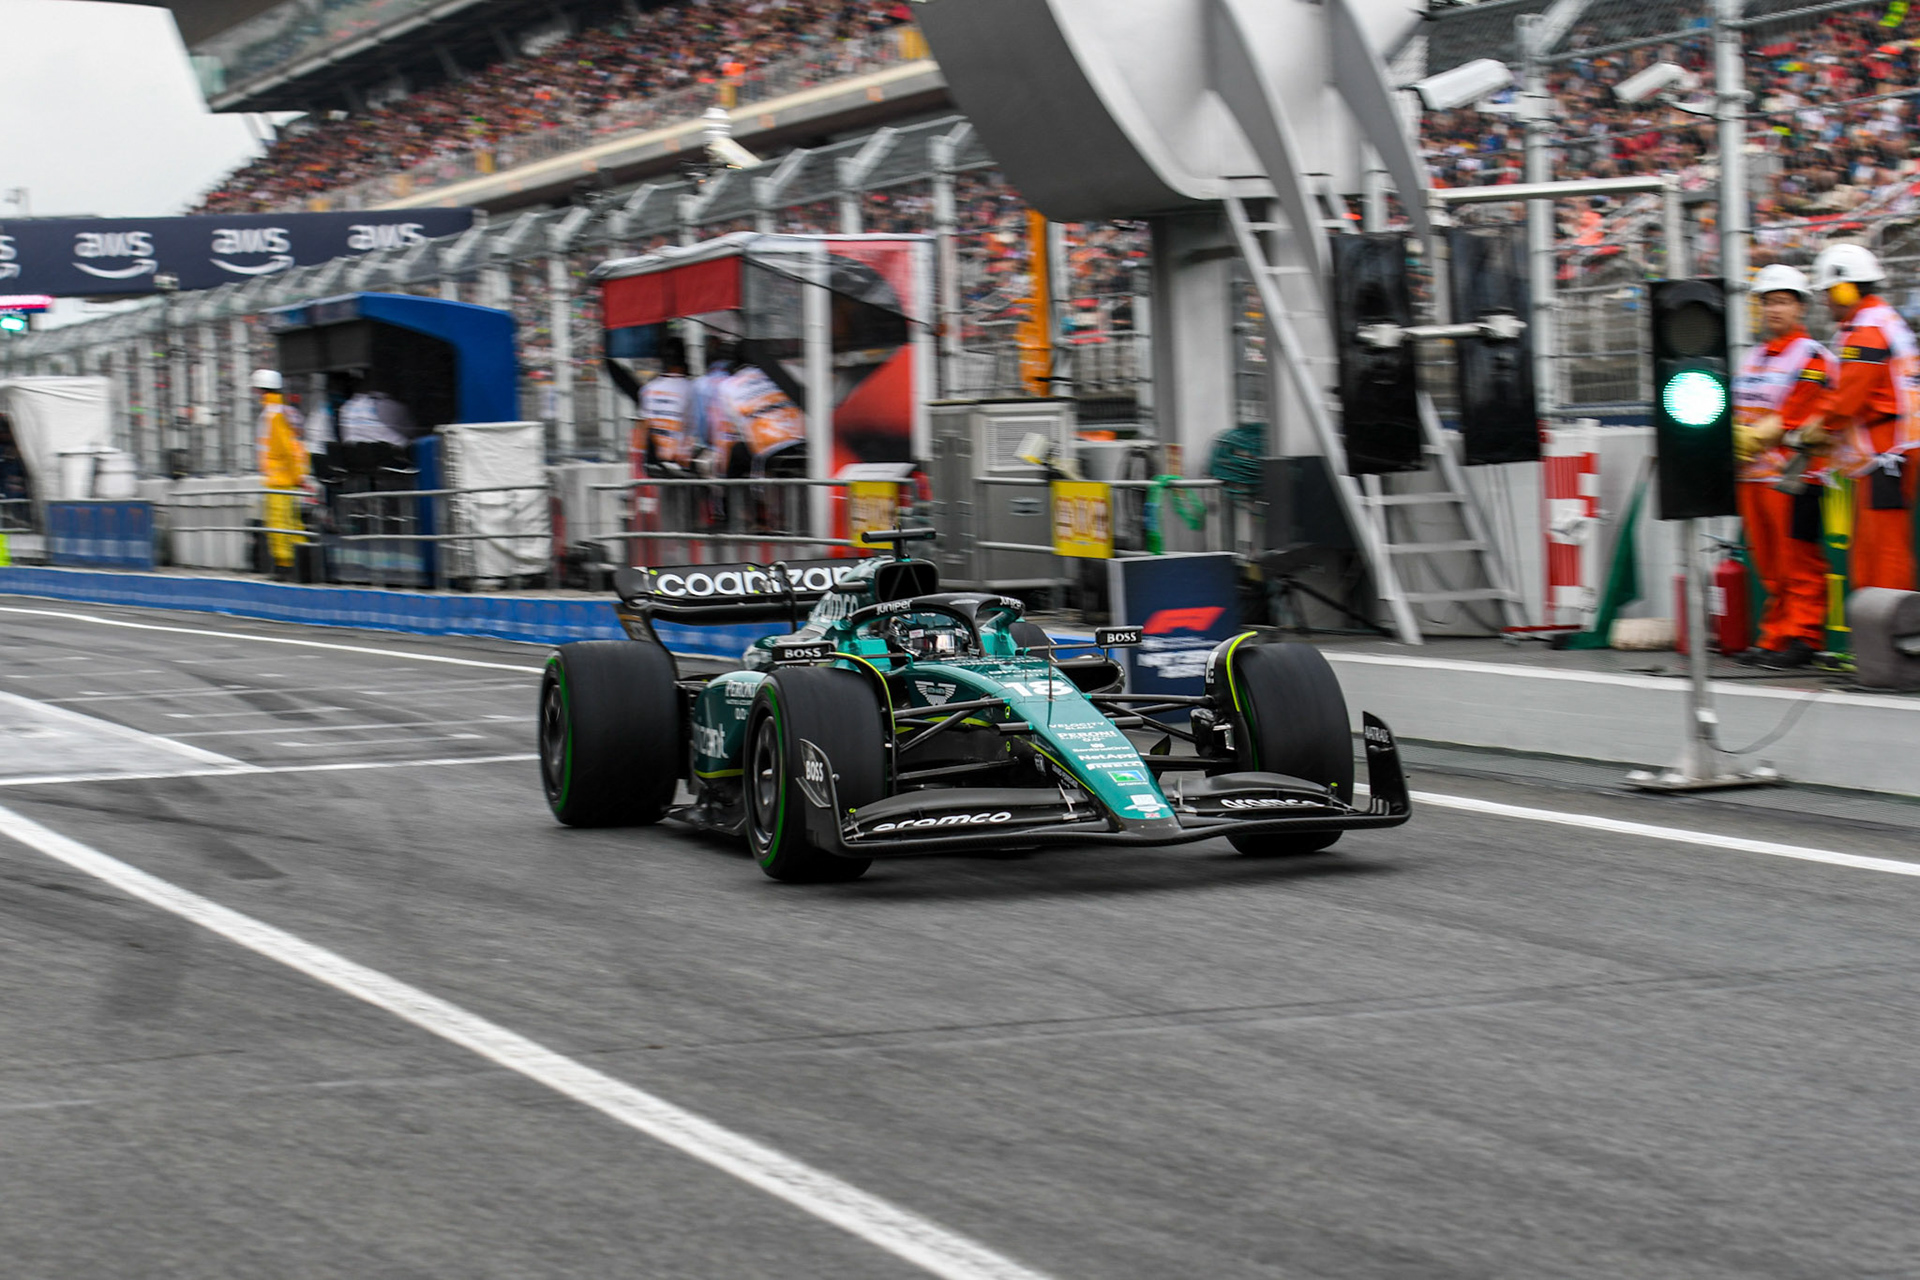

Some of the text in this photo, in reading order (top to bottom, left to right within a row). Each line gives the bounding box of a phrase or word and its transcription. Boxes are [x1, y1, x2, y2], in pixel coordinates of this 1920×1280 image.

[73, 231, 155, 258] aws
[211, 227, 291, 254] aws
[347, 223, 425, 250] aws
[1106, 632, 1137, 643] BOSS
[784, 648, 822, 658] BOSS
[1005, 681, 1074, 697] 18
[1057, 730, 1117, 739] PERONI
[1078, 753, 1139, 761] NetApp
[805, 760, 824, 783] BOSS
[1220, 799, 1326, 809] aramco
[872, 811, 1012, 832] aramco
